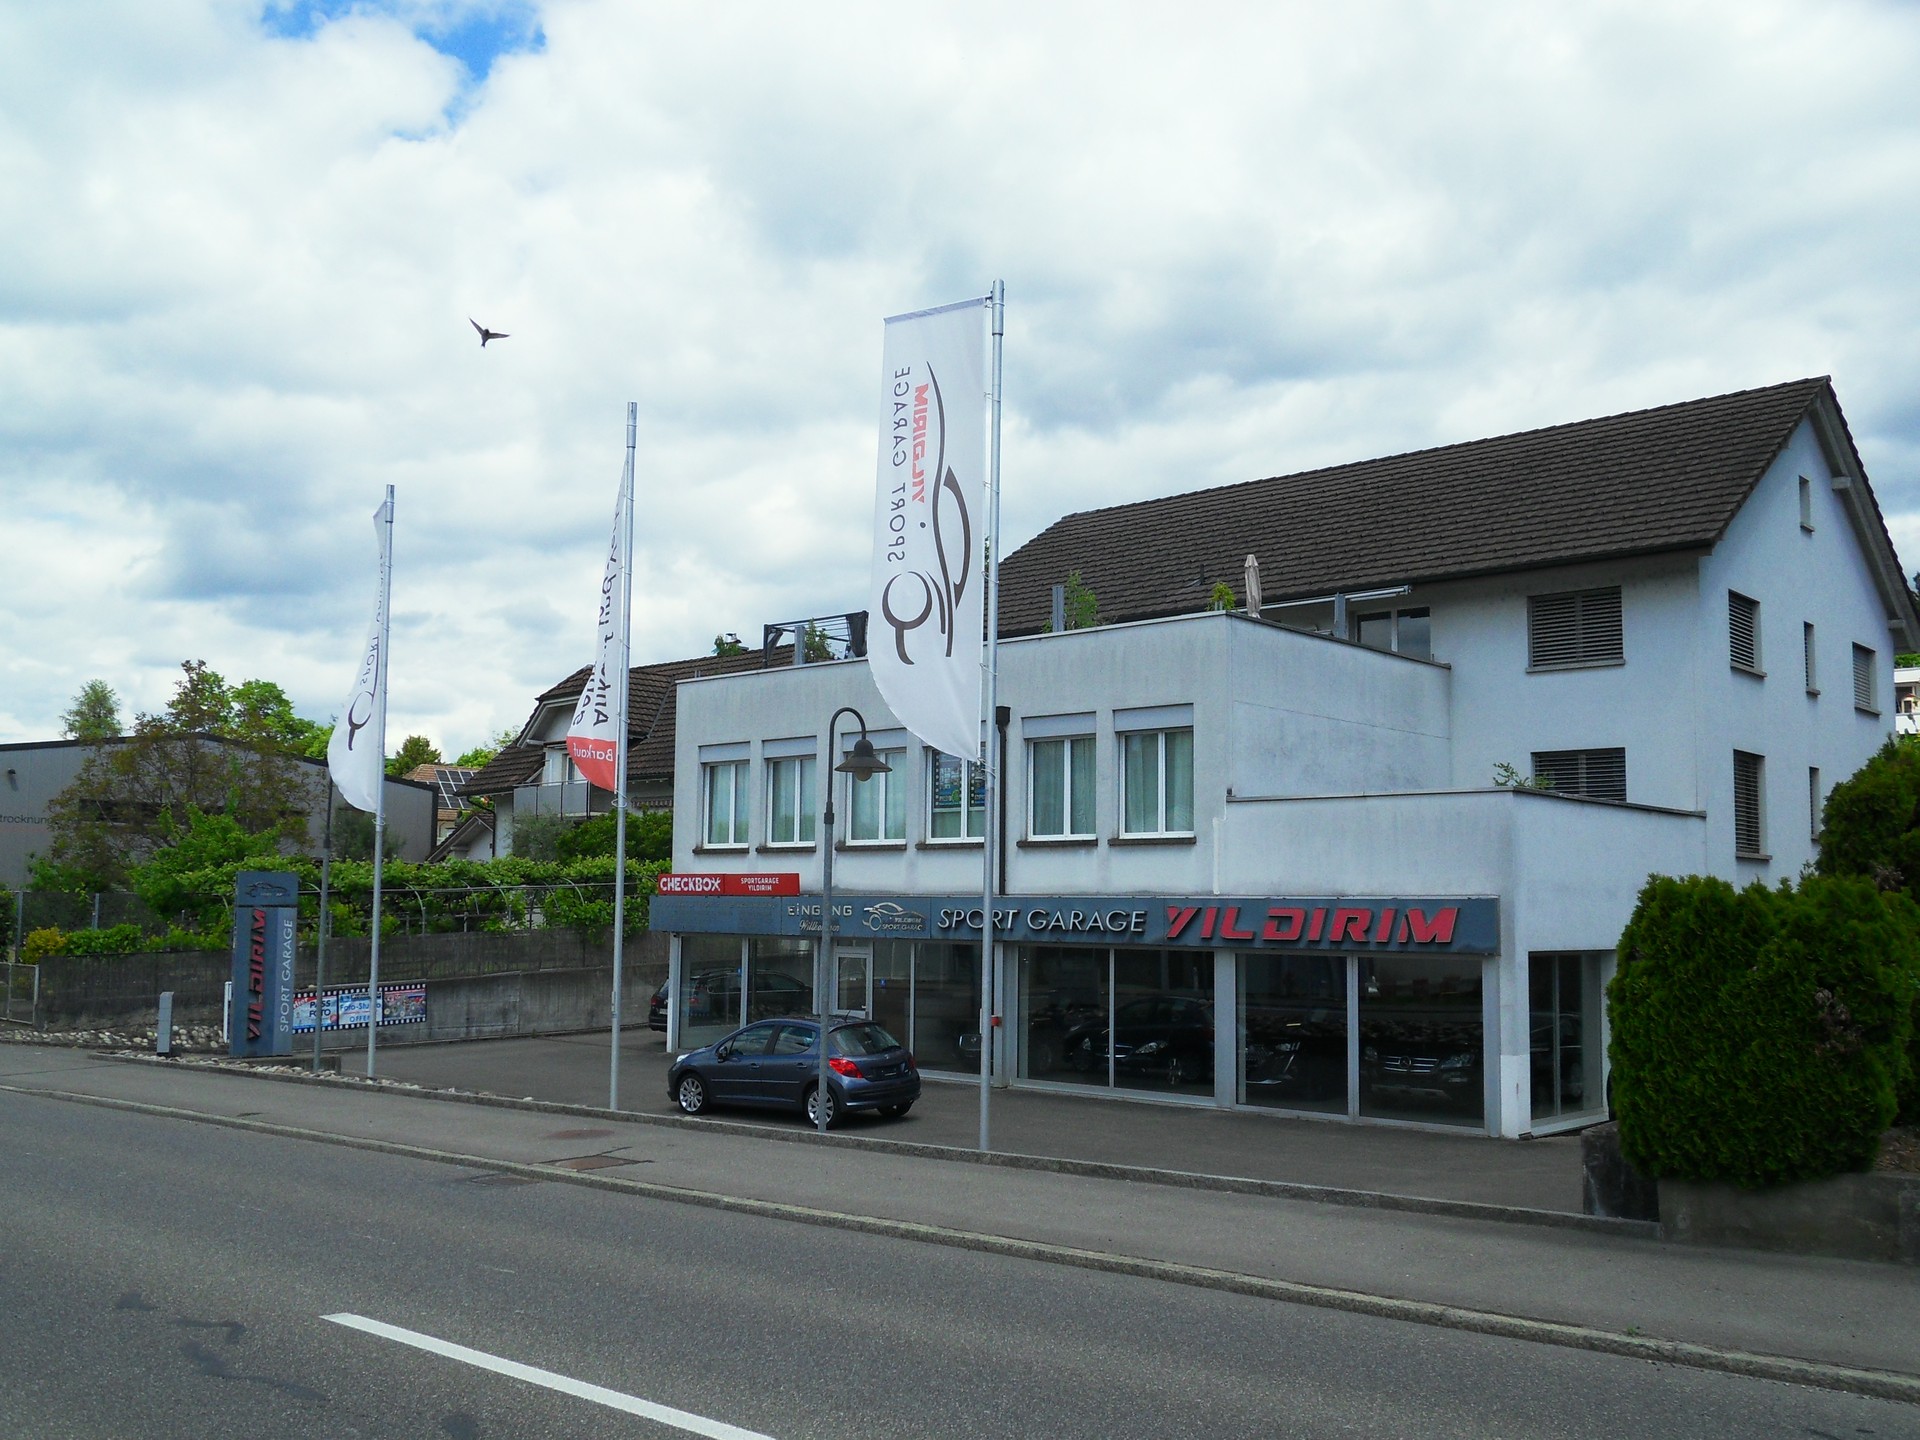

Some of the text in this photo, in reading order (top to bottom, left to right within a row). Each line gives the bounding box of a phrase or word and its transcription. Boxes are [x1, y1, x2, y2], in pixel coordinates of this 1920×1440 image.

[660, 877, 722, 892] CHECKBOX
[740, 877, 779, 885] SPORTGARAGE
[937, 908, 1147, 932] SPORT GARAGE
[1166, 906, 1460, 943] YILDIRIM
[280, 919, 293, 1033] SPORT GARAGE
